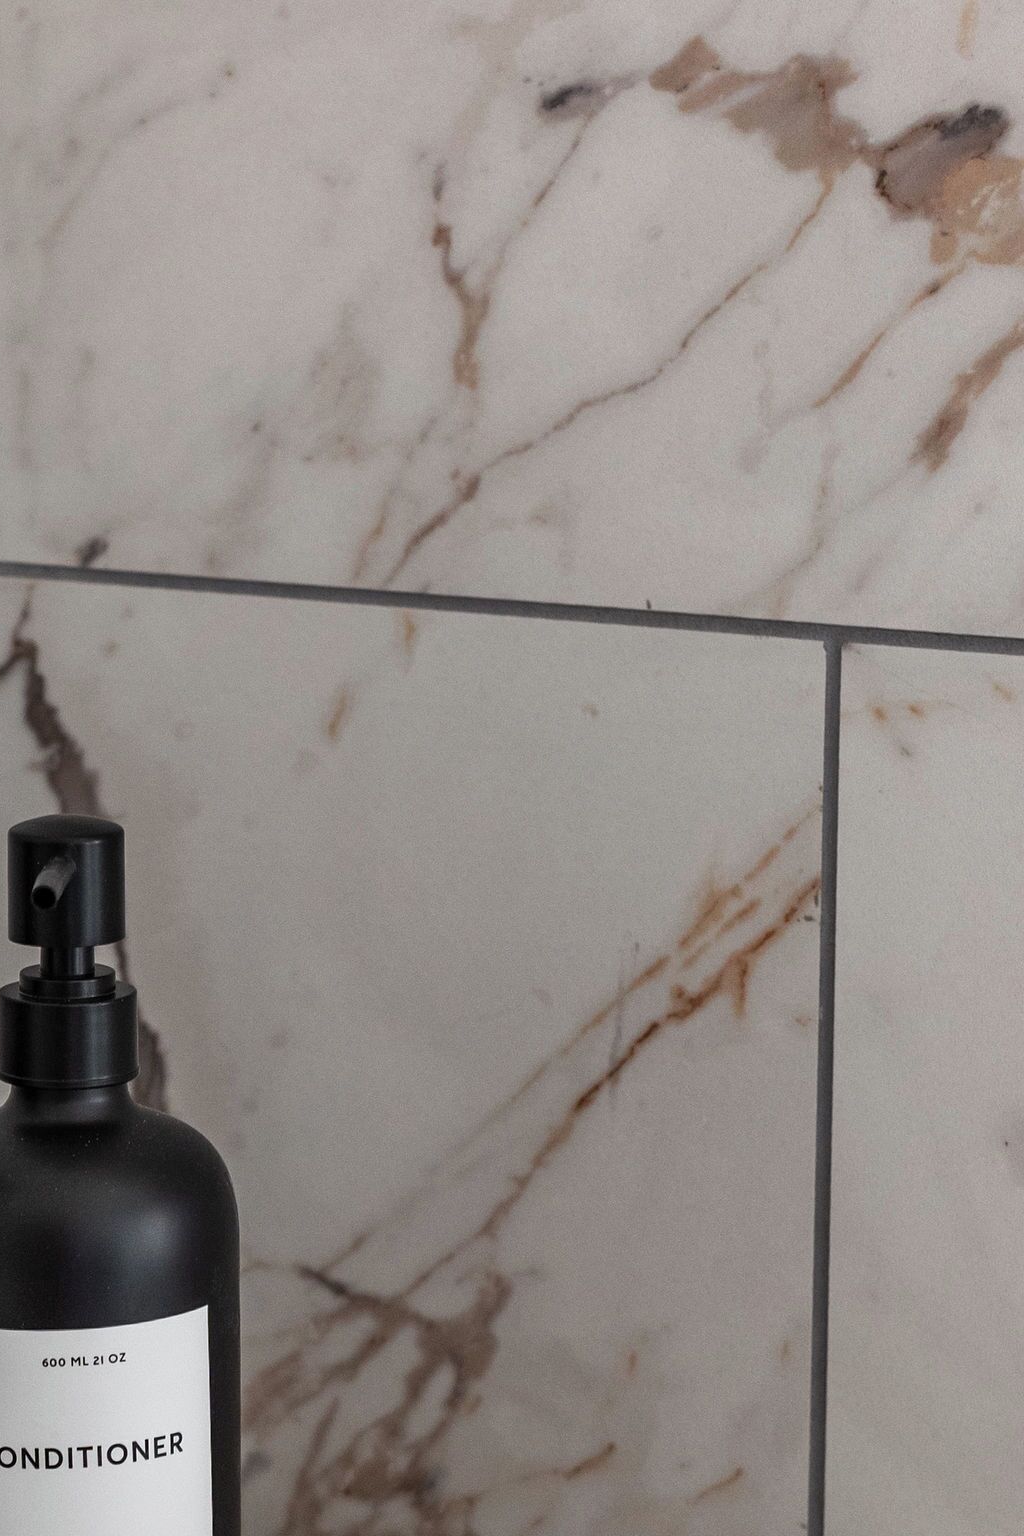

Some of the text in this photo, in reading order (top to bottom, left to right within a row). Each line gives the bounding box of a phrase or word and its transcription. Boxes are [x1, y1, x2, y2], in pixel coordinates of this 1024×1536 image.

[41, 1351, 127, 1368] 600 ML 21 OZ
